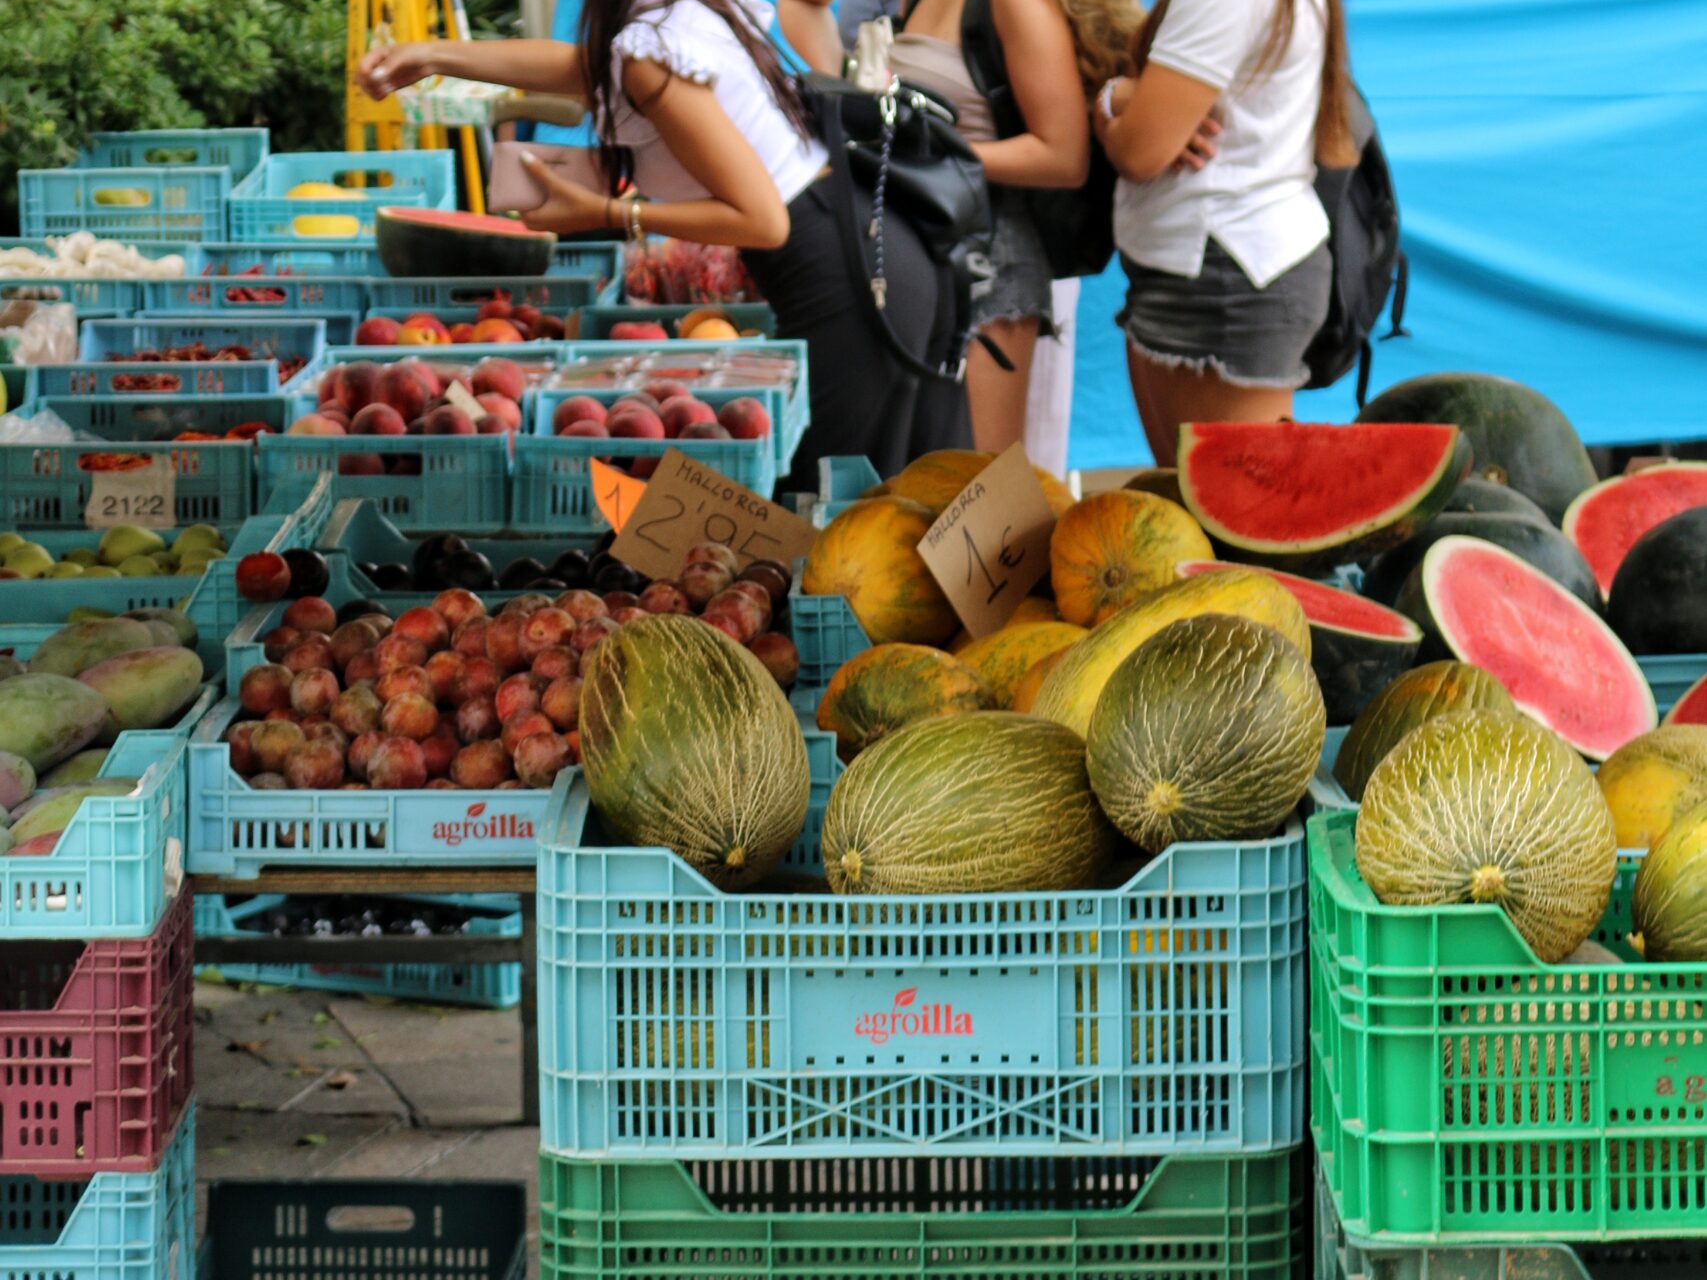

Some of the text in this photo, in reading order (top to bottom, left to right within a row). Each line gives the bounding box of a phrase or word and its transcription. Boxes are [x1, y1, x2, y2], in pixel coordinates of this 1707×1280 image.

[102, 495, 164, 516] 2122
[432, 814, 535, 847] agroilla
[854, 1002, 974, 1045] agroilla
